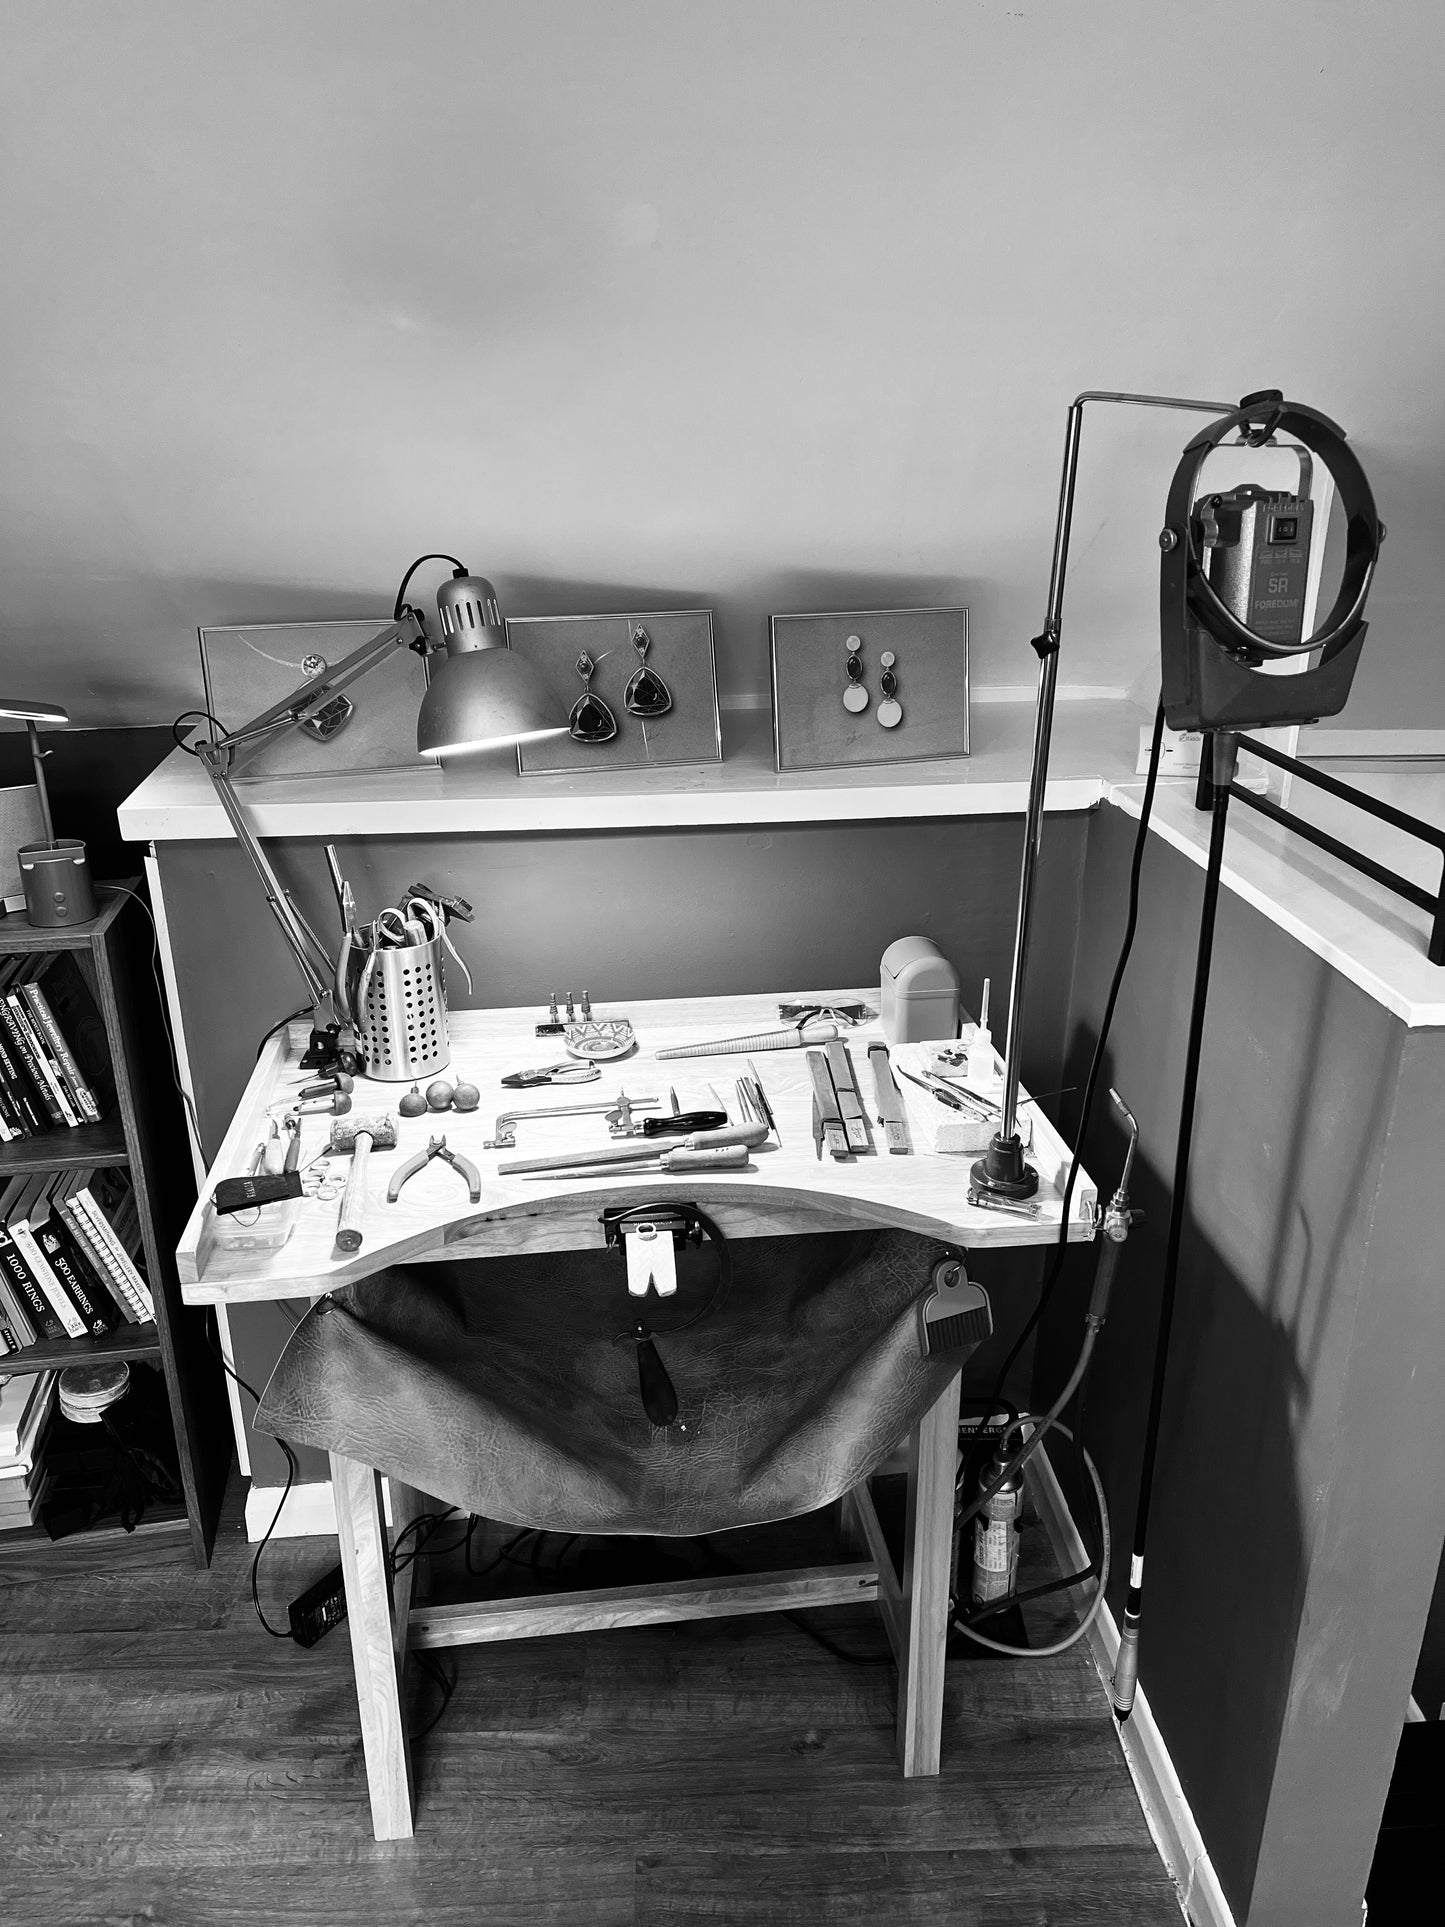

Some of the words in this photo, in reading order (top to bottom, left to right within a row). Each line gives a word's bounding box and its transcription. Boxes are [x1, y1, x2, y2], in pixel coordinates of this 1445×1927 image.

[1254, 599, 1298, 609] FOREDOM
[1268, 578, 1289, 593] SR
[29, 989, 50, 1022] Practical
[43, 1016, 63, 1052] Jewellery
[61, 1052, 75, 1075] Repair
[4, 1058, 17, 1079] SETTING
[20, 1046, 28, 1054] on
[24, 1054, 40, 1079] Precious
[37, 1079, 54, 1101] Metals
[6, 1253, 27, 1280] 1000
[22, 1281, 45, 1312] RINGS
[54, 1257, 71, 1275] 500
[66, 1274, 94, 1314] EARRINGS
[116, 1252, 133, 1275] JEWELLERY
[131, 1275, 144, 1294] MAKERS
